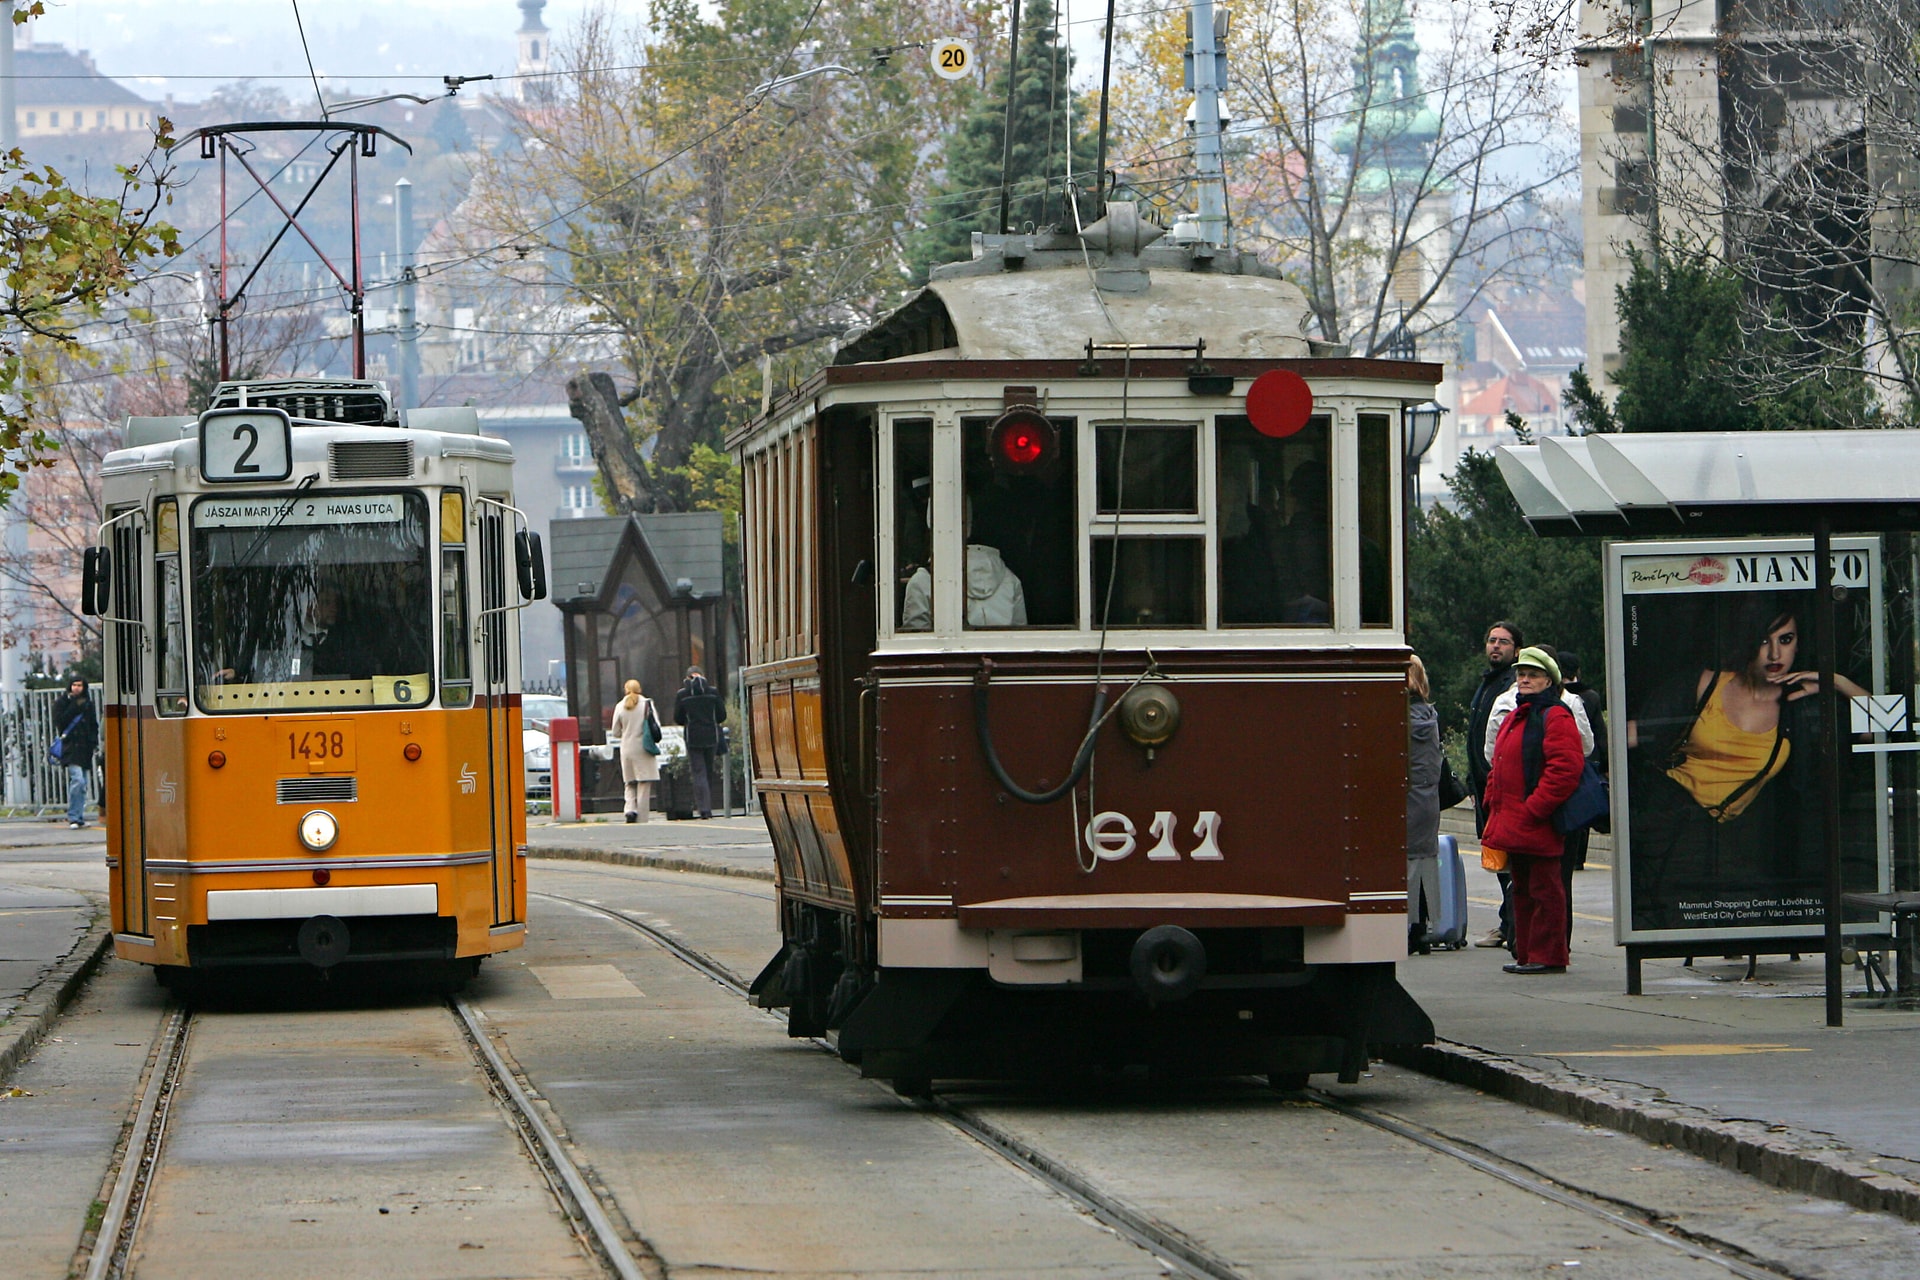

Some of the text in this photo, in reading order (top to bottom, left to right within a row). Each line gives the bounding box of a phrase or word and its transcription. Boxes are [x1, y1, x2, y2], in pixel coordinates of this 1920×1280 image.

[942, 49, 965, 67] 20
[233, 424, 260, 473] 2
[205, 505, 242, 518] JÁSZAI
[244, 506, 271, 517] MARI
[306, 504, 315, 517] 2
[327, 504, 361, 515] HAVAS
[364, 503, 394, 515] UTCA
[1631, 605, 1639, 646] mango.com
[393, 680, 412, 702] 6
[288, 731, 343, 760] 1438
[1085, 811, 1224, 861] 611
[1679, 901, 1712, 909] Mammut
[1714, 900, 1751, 909] Shopping
[1683, 911, 1718, 920] WestEnd
[1719, 911, 1735, 920] City
[1736, 910, 1762, 919] Center
[1786, 909, 1803, 917] utca
[1805, 908, 1825, 916] 19-21
